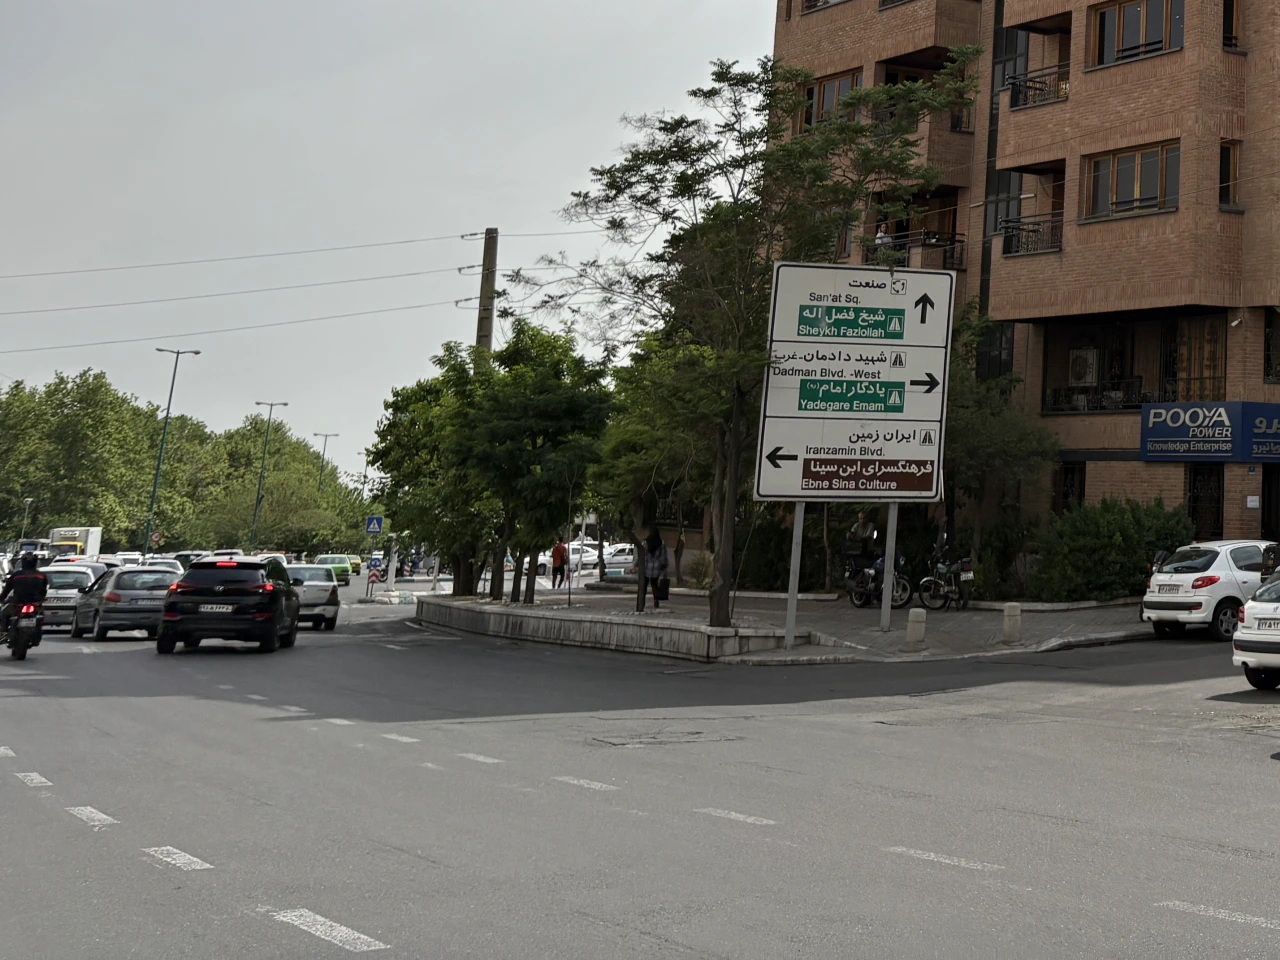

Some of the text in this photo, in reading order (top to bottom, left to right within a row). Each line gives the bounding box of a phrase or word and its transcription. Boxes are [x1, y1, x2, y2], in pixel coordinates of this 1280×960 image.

[848, 279, 887, 289] صنعت
[809, 292, 861, 305] San'at Sq.
[803, 307, 886, 326] شیخ فضل اله
[799, 325, 885, 338] Sheykh Fazlollah
[854, 350, 887, 365] شهید
[773, 367, 817, 378] Dadman
[820, 368, 846, 378] Blvd.
[848, 382, 886, 397] یادگار
[800, 399, 885, 412] Yadegare Emam
[1148, 407, 1231, 428] POOYA
[849, 429, 916, 443] ایران زمین
[1189, 427, 1232, 438] POWER
[805, 445, 885, 457] Iranzamin Blvd.
[1147, 441, 1232, 452] Knowledge Enterprise
[1252, 442, 1270, 453] نیرو
[810, 460, 933, 476] فرهنگسرای ابن سینا
[802, 479, 897, 490] Ebne Sina Culture
